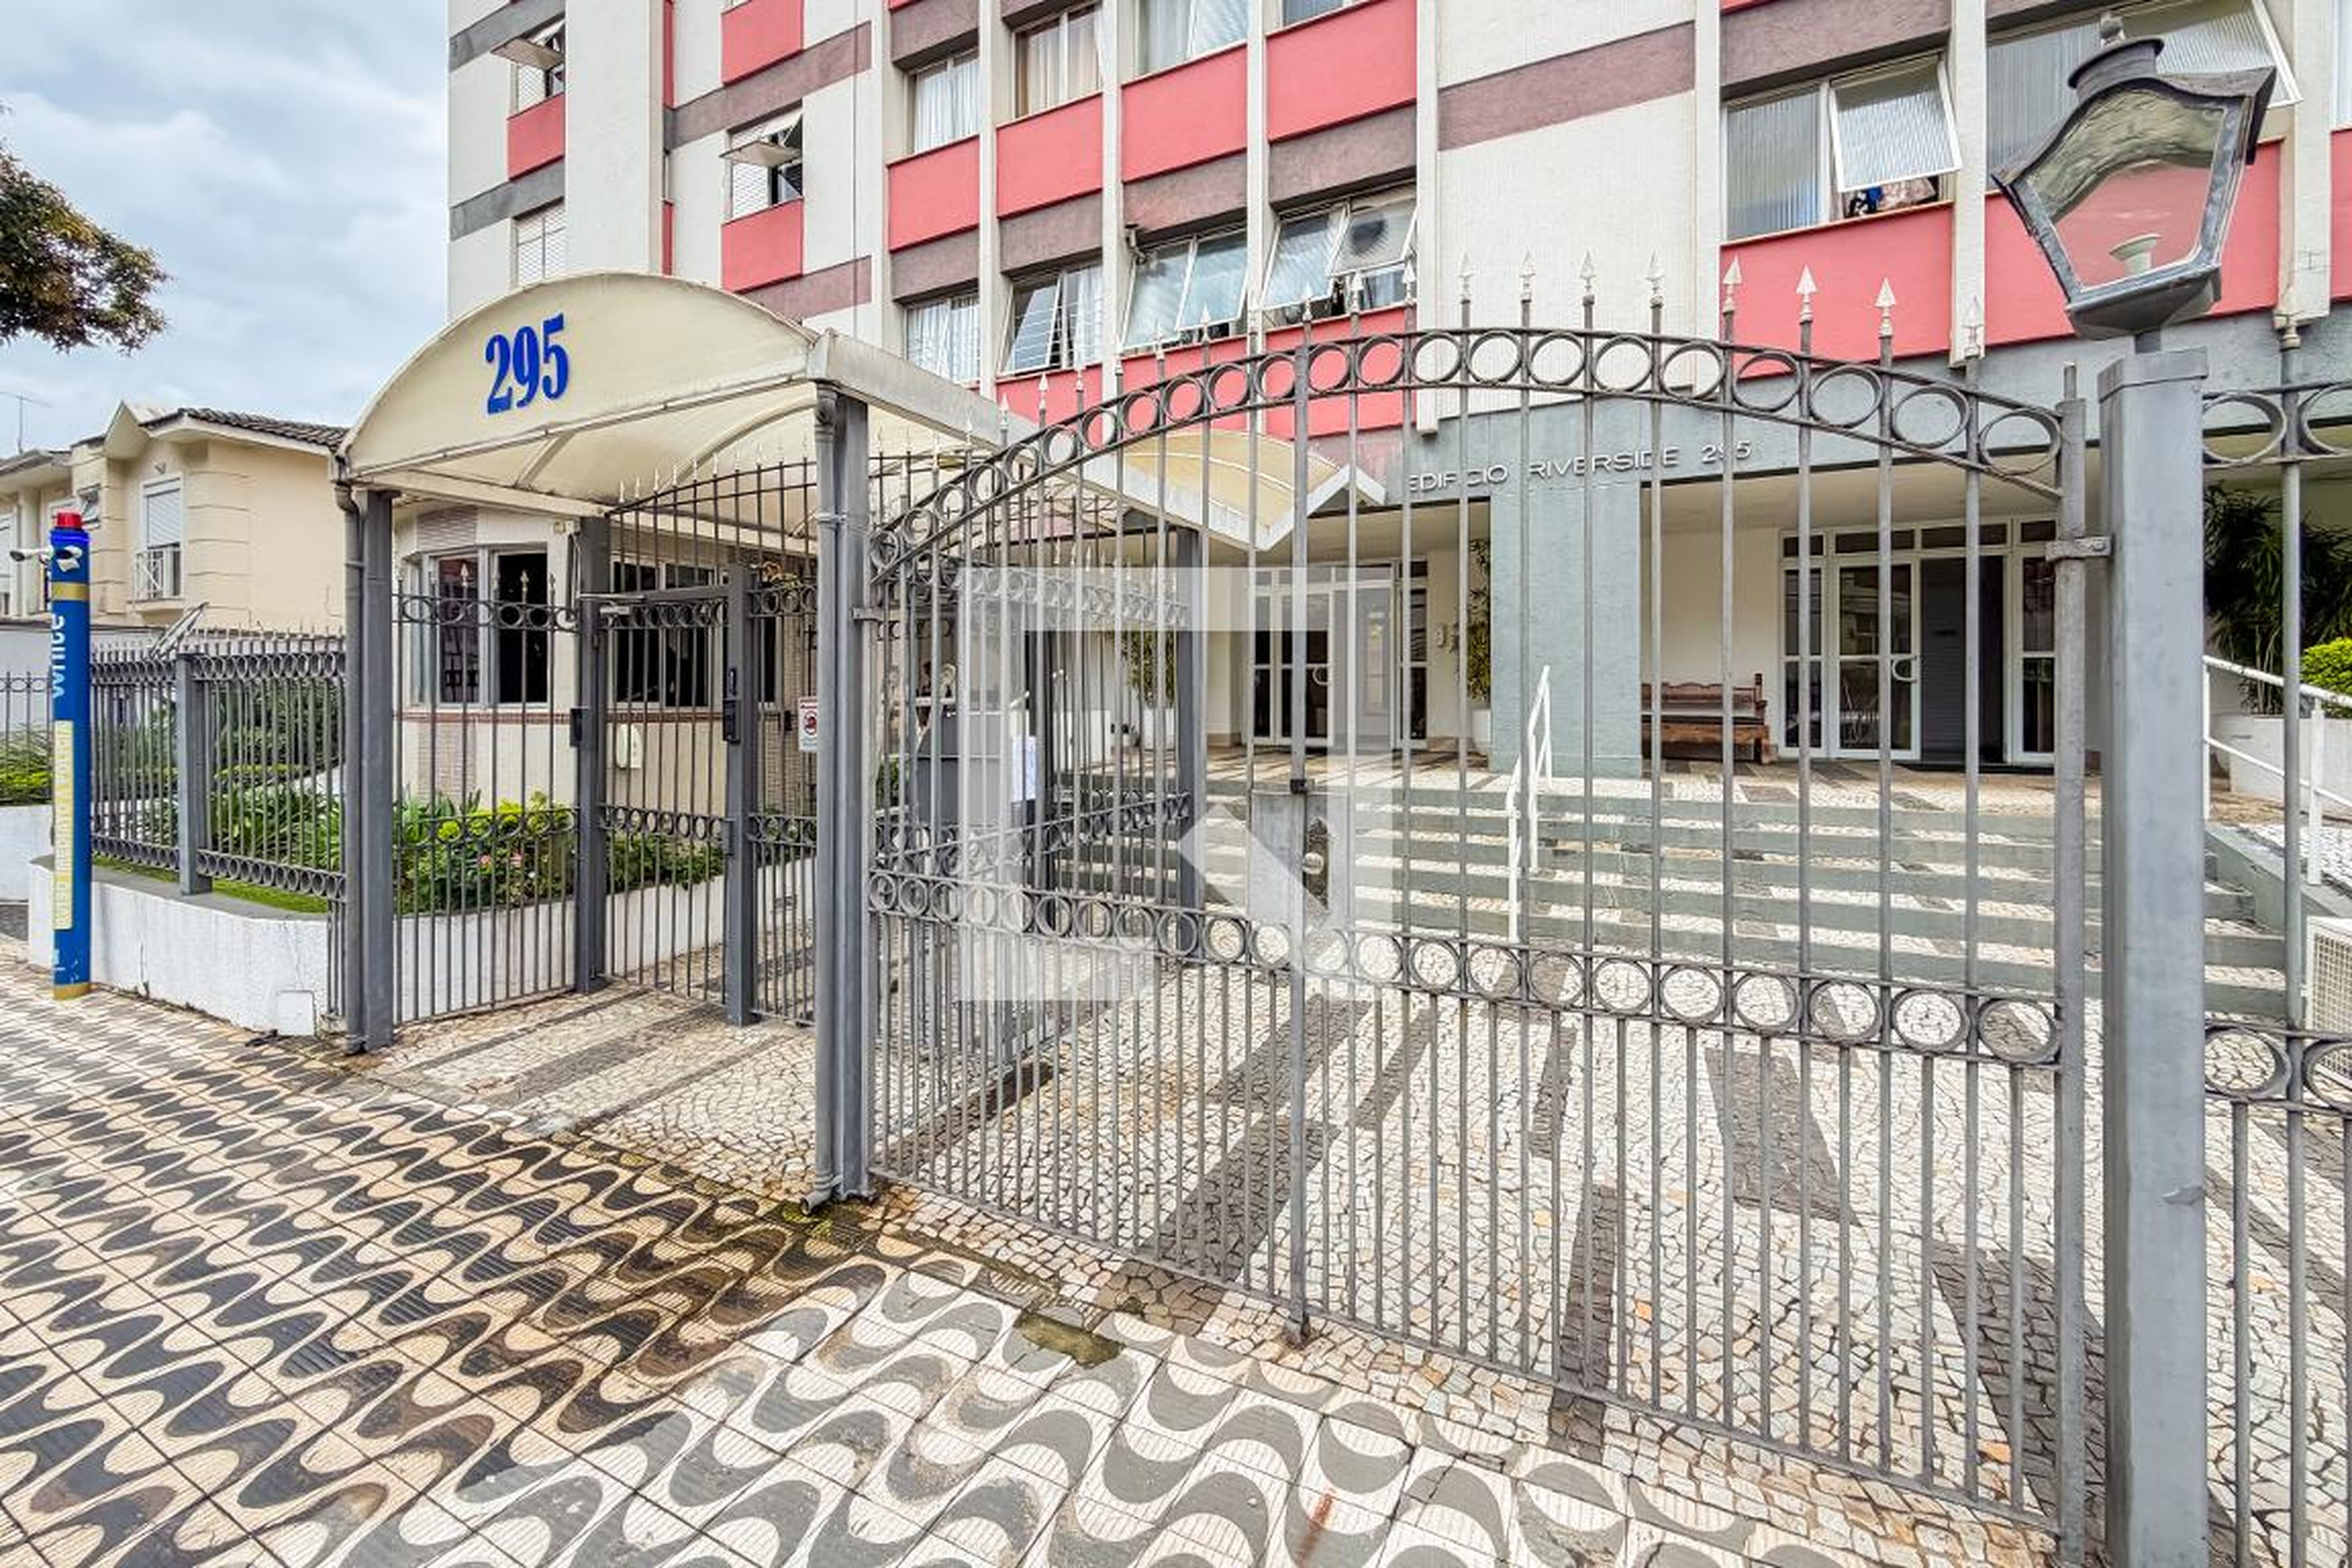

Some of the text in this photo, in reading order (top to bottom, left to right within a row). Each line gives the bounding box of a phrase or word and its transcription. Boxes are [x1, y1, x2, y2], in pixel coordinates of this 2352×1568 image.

[485, 312, 569, 415] 295
[1408, 464, 1508, 491] EDIFCIO
[1528, 447, 1680, 477] RIVERSIDE
